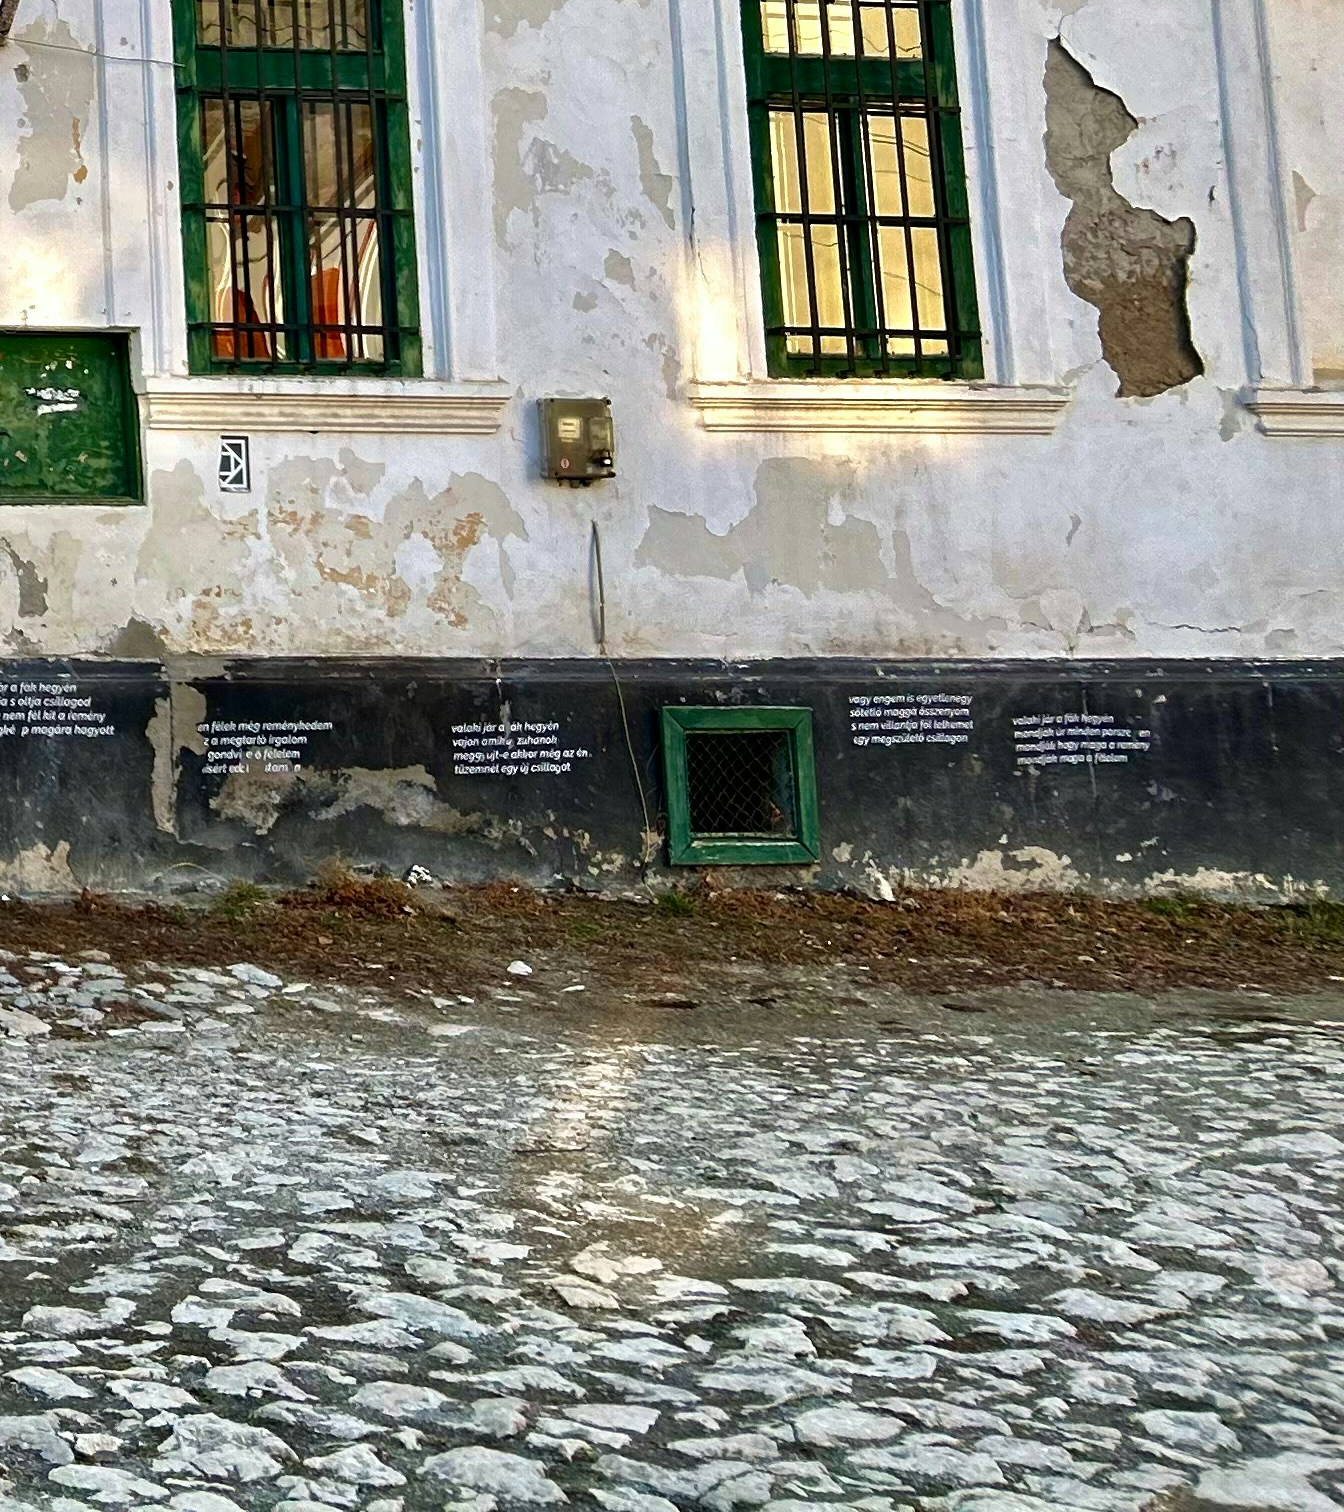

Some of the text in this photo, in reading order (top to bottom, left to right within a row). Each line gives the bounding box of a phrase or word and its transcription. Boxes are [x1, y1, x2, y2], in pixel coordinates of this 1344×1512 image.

[10, 684, 17, 692] a
[39, 682, 77, 695] hegyén
[10, 698, 16, 706] s
[43, 696, 92, 709] csillagod
[848, 695, 872, 706] vagy
[2, 712, 25, 721] nem
[58, 712, 65, 721] a
[1056, 716, 1063, 724] a
[31, 724, 72, 738] magára
[74, 724, 115, 738] hagyott
[238, 720, 261, 733] még
[524, 720, 559, 734] hegyén
[850, 722, 857, 731] s
[858, 722, 879, 730] nem
[211, 737, 219, 746] a
[269, 734, 308, 747] irgalom
[452, 736, 479, 749] vajon
[539, 748, 561, 761] még
[563, 750, 575, 758] az
[501, 766, 519, 776] egy
[531, 761, 571, 775] csillagot
